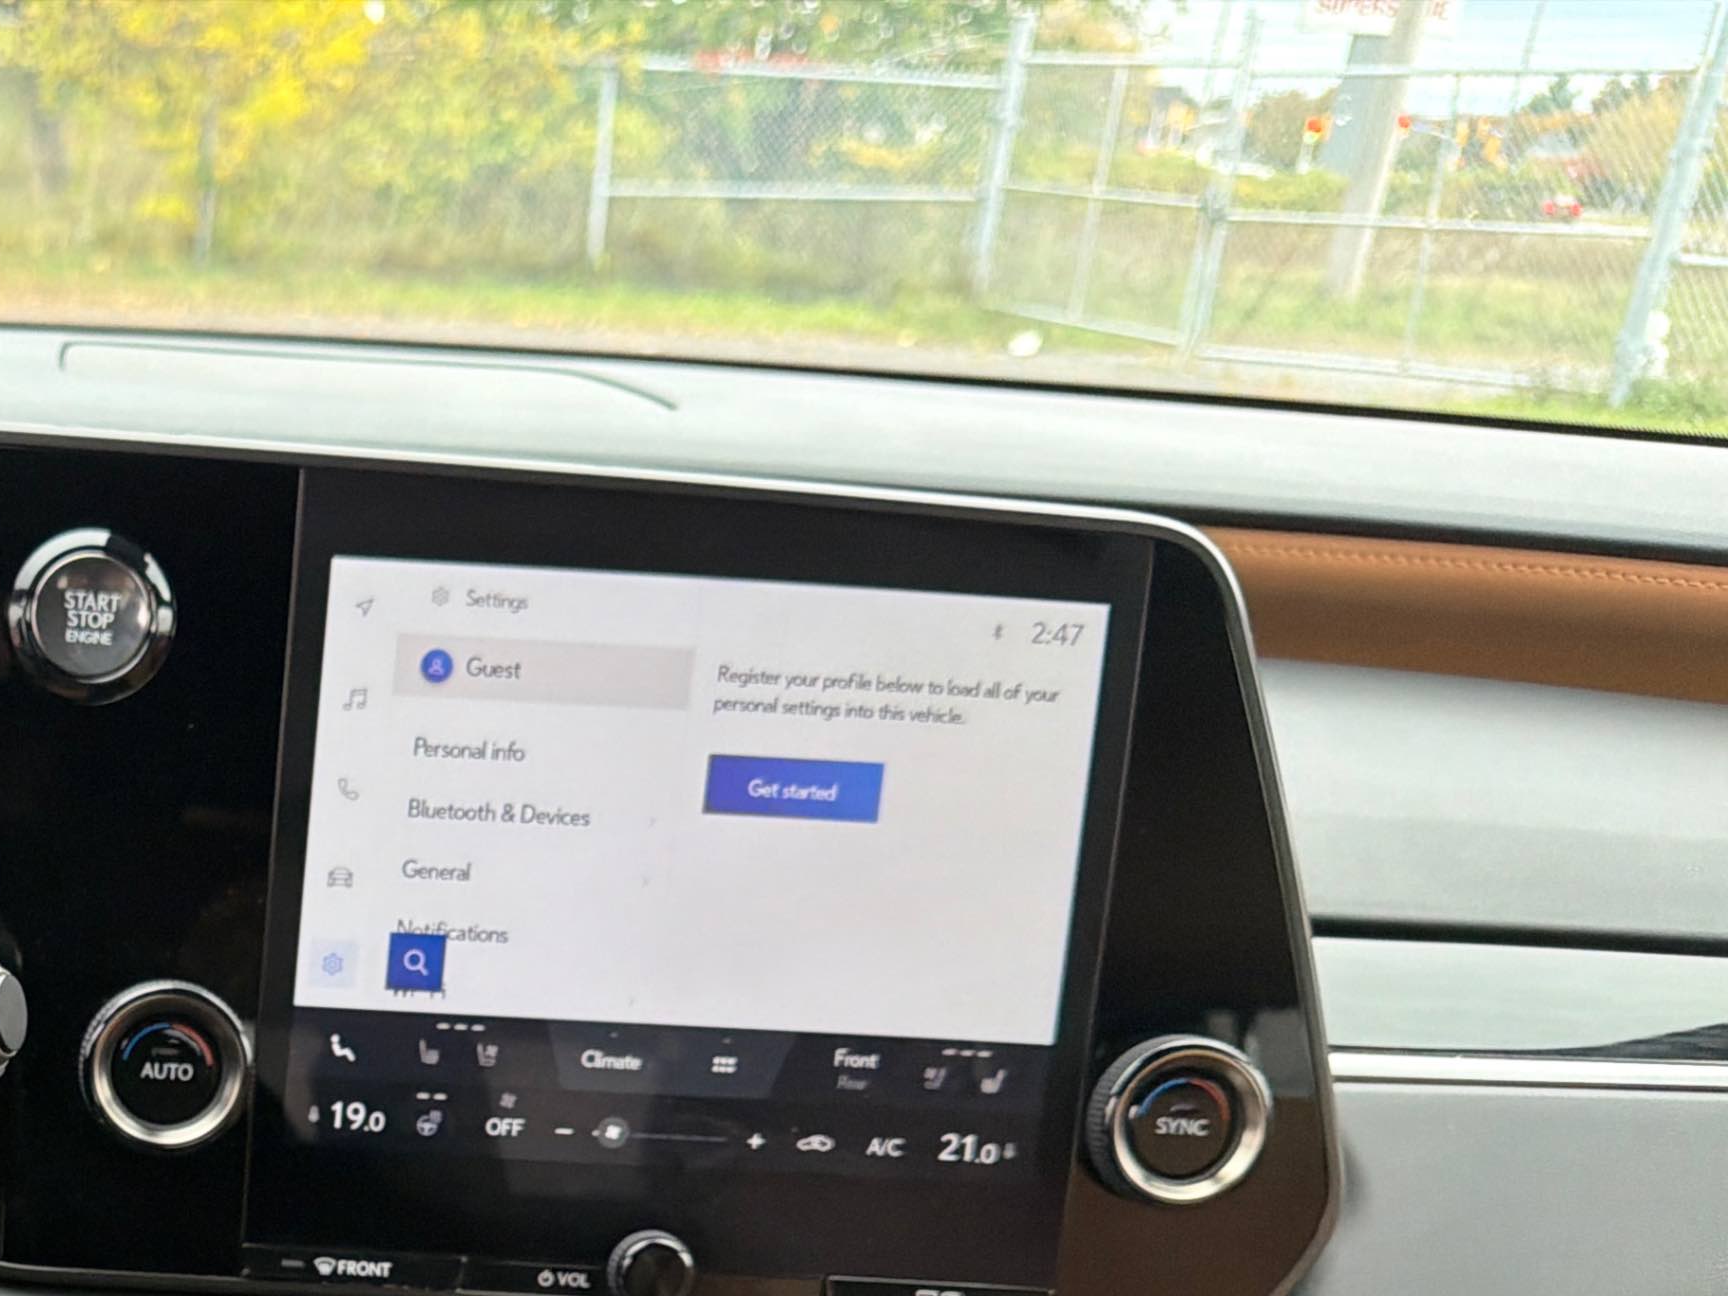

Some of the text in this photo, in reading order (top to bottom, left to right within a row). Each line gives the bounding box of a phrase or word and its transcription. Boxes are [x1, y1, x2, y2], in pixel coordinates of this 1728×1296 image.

[64, 591, 120, 612] START
[466, 589, 529, 613] Settings
[67, 611, 114, 629] STOP
[65, 629, 113, 646] ENGINE
[1032, 621, 1085, 646] 2:47
[466, 656, 522, 679] Guest
[717, 664, 1060, 705] Register your profile below to load all of your
[713, 698, 779, 714] personal
[782, 701, 841, 721] settings
[845, 704, 874, 719] into
[879, 704, 906, 721] this
[413, 735, 526, 762] Personal info
[748, 779, 839, 801] Get started
[407, 798, 591, 827] Bluetooth & Devices
[401, 859, 472, 882] General
[580, 1049, 642, 1071] Climate
[833, 1047, 880, 1069] Front
[140, 1060, 194, 1082] AUTO
[330, 1100, 386, 1133] 19.0
[484, 1116, 525, 1137] OFF
[1154, 1116, 1211, 1137] SYNC
[865, 1136, 906, 1158] A/C
[937, 1132, 1001, 1165] 21.0
[336, 1257, 392, 1278] FRONT
[557, 1270, 591, 1289] VOL
